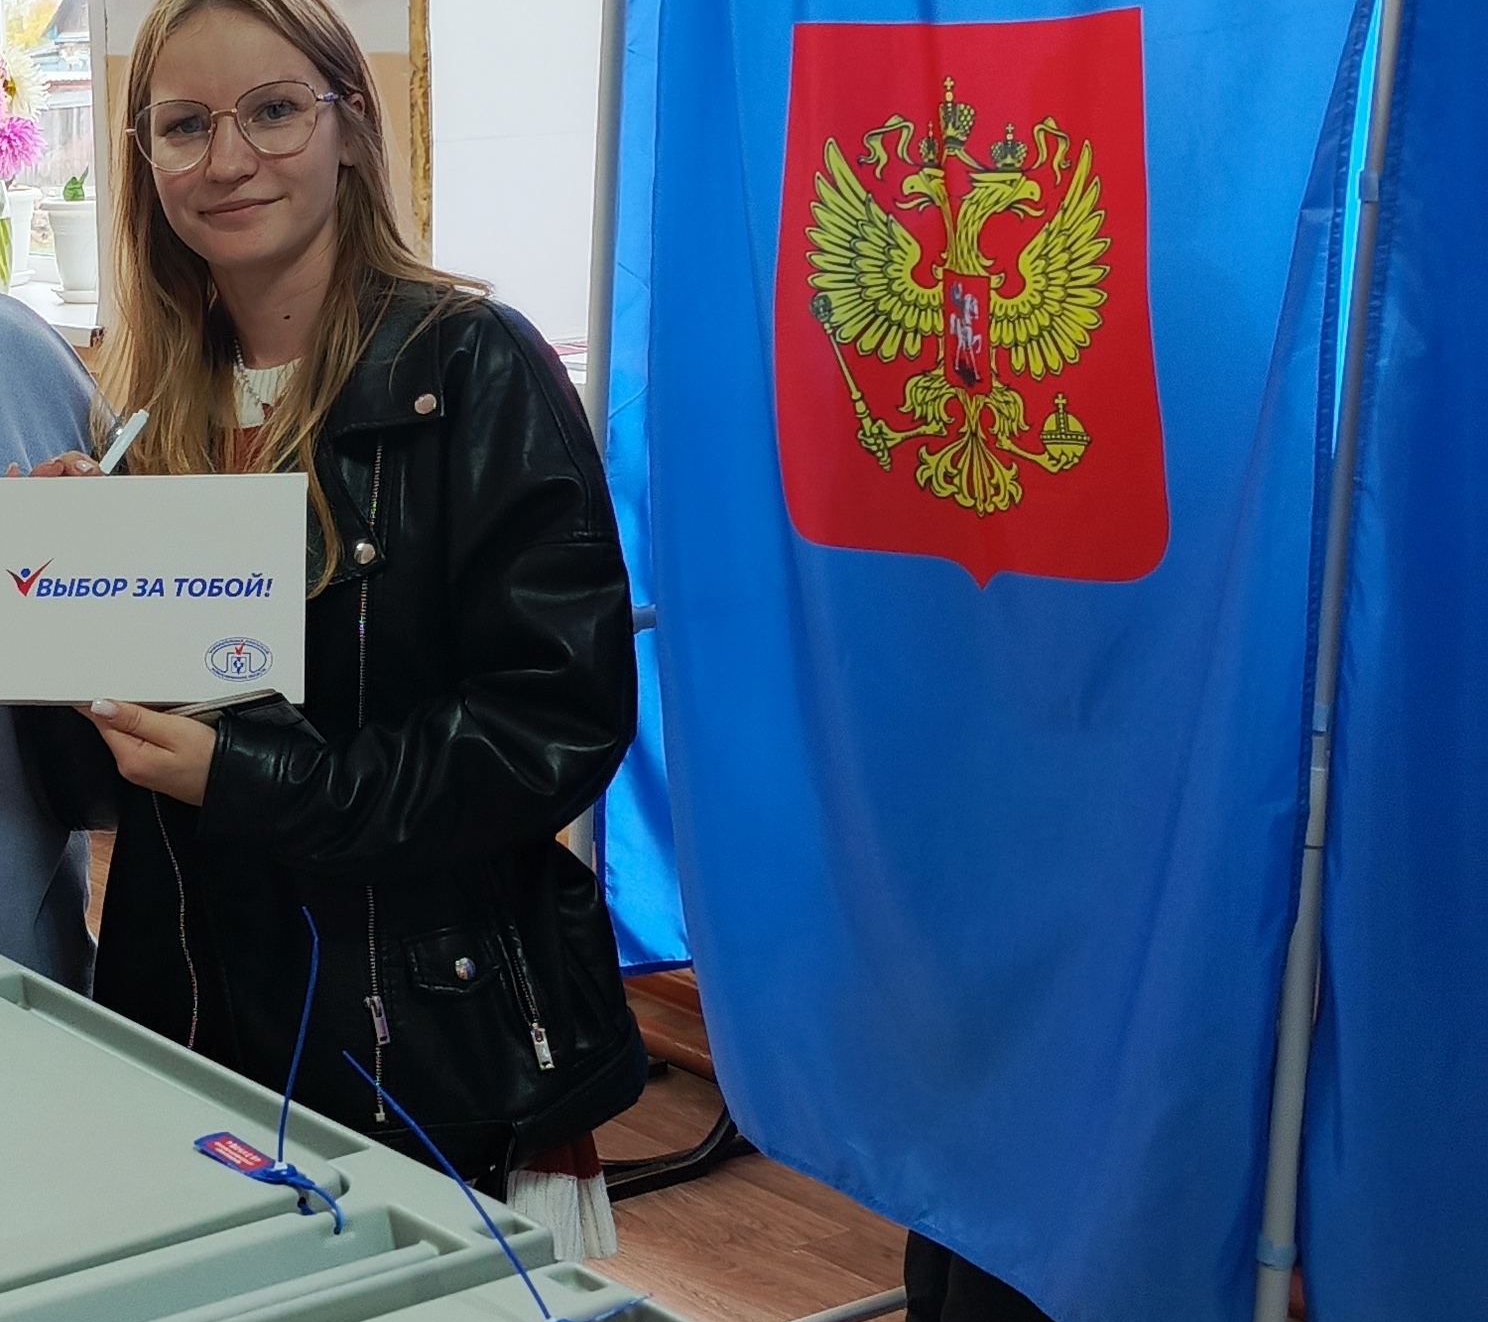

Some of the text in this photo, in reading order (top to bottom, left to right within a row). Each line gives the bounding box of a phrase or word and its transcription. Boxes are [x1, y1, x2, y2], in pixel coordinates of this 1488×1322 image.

[36, 571, 274, 598] ВЫБОР ЗА ТОБОЙ!
